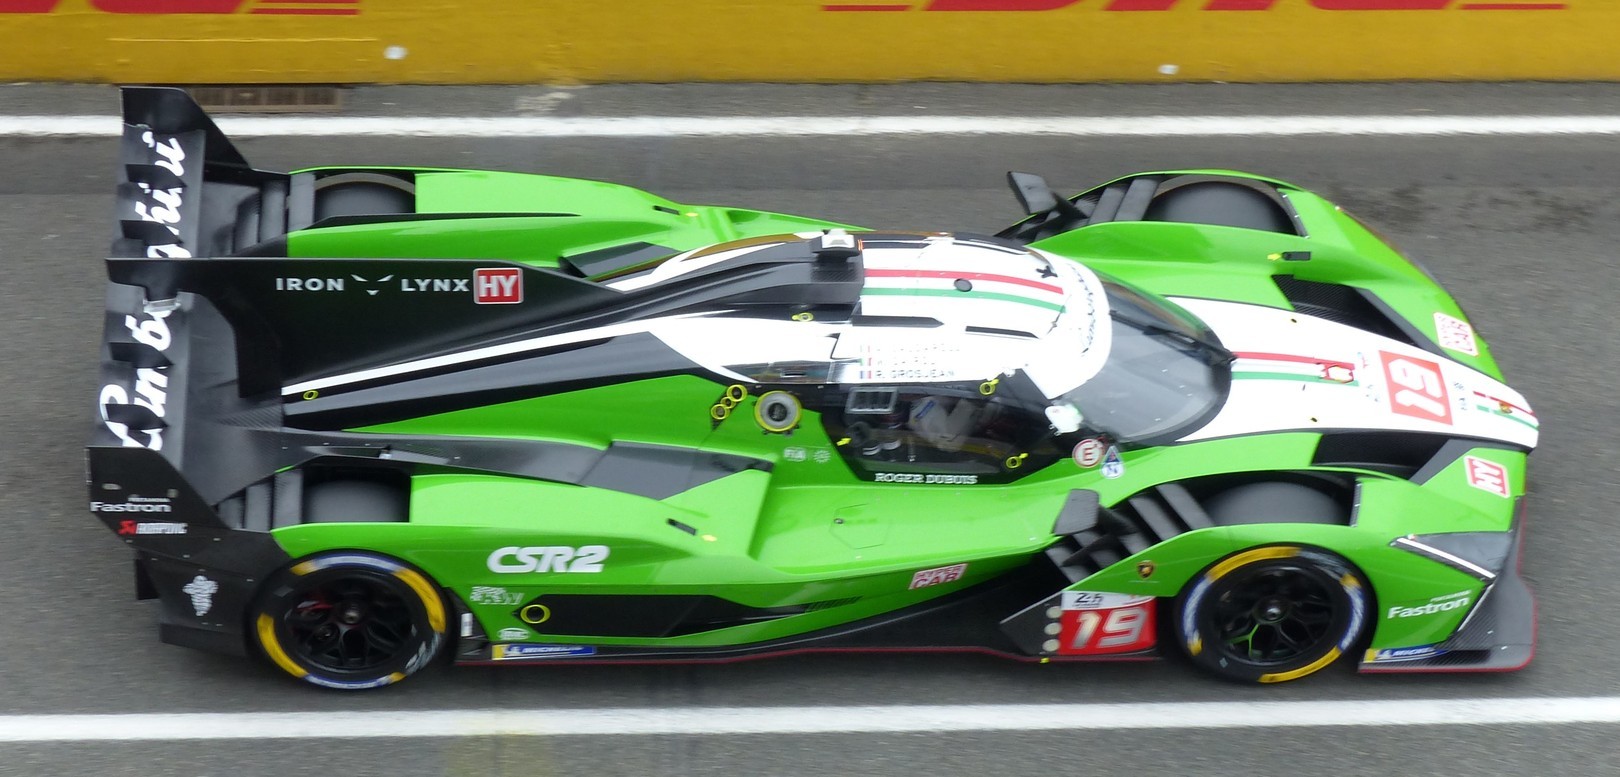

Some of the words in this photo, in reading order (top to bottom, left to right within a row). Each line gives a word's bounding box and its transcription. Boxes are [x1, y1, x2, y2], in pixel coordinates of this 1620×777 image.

[275, 277, 345, 291] IRON
[400, 278, 470, 292] LYNX
[478, 274, 518, 298] HY
[1387, 357, 1447, 418] 19
[874, 472, 924, 483] ROGER
[925, 473, 978, 485] DUBUIS
[1469, 459, 1506, 495] HY
[90, 501, 172, 513] Fastron
[486, 545, 611, 574] CSR2
[912, 572, 960, 589] CAR
[1387, 597, 1470, 619] Fastron
[1071, 608, 1149, 649] 19
